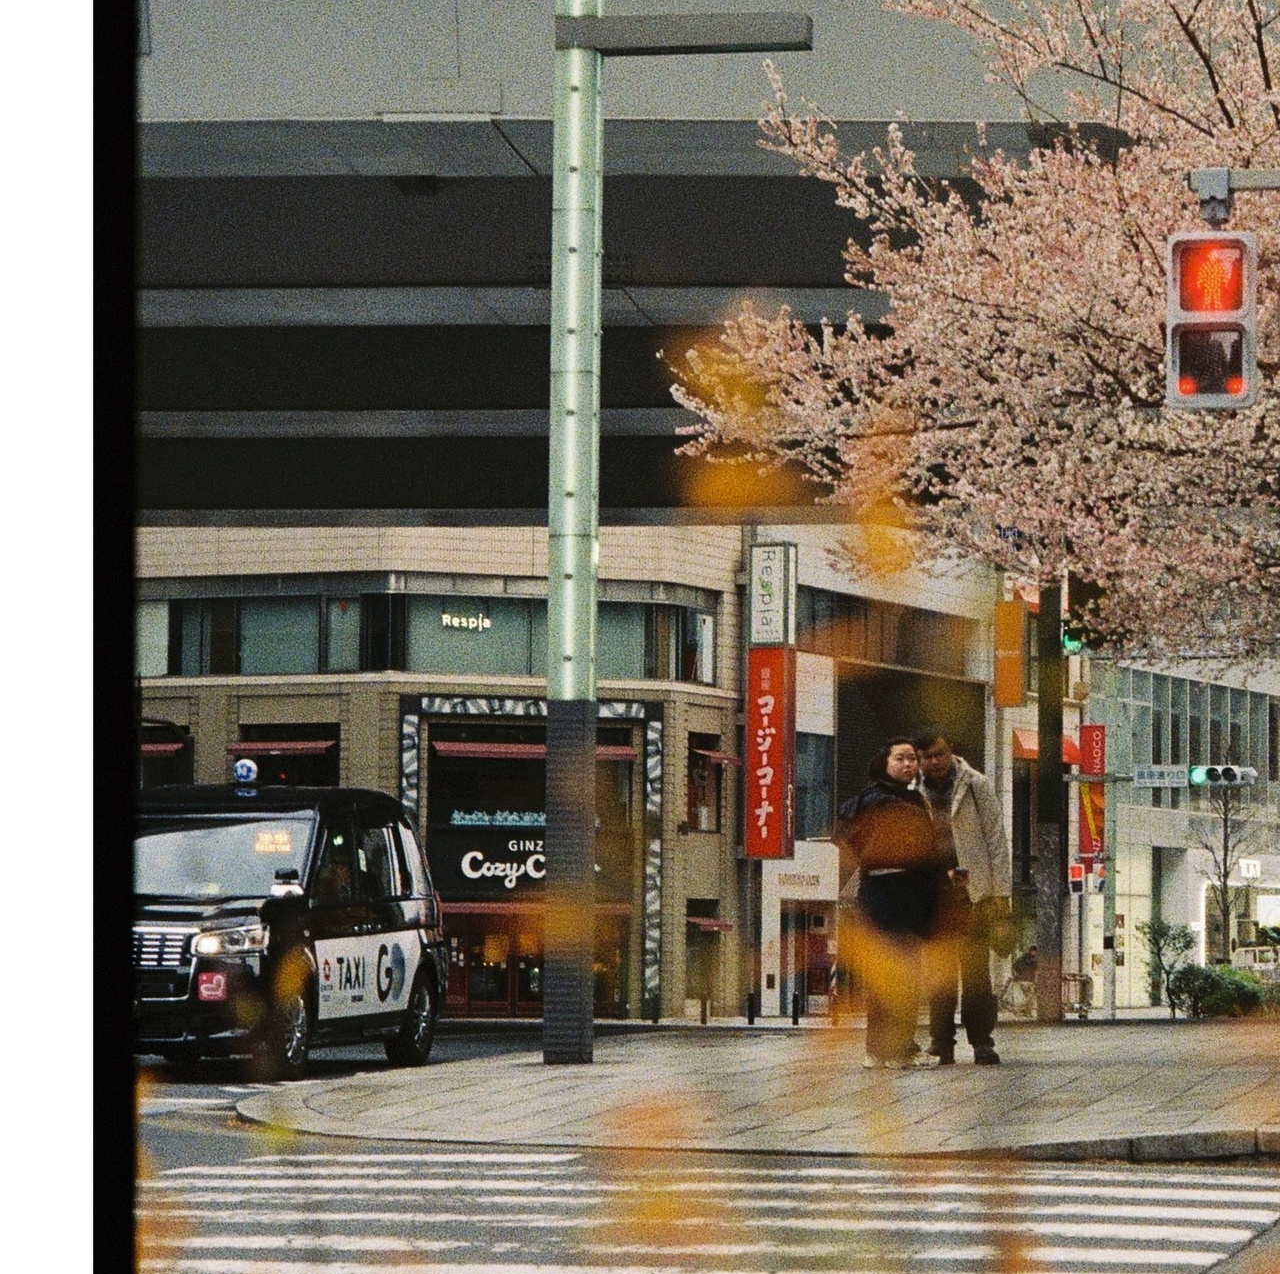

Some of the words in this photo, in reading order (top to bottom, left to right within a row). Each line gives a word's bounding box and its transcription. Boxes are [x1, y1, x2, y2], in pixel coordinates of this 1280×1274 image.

[754, 695, 776, 839] コージーコーナー
[1093, 730, 1102, 773] NAOCO
[508, 840, 544, 852] GINZ
[461, 851, 525, 889] Cozy
[336, 956, 366, 991] TAXI
